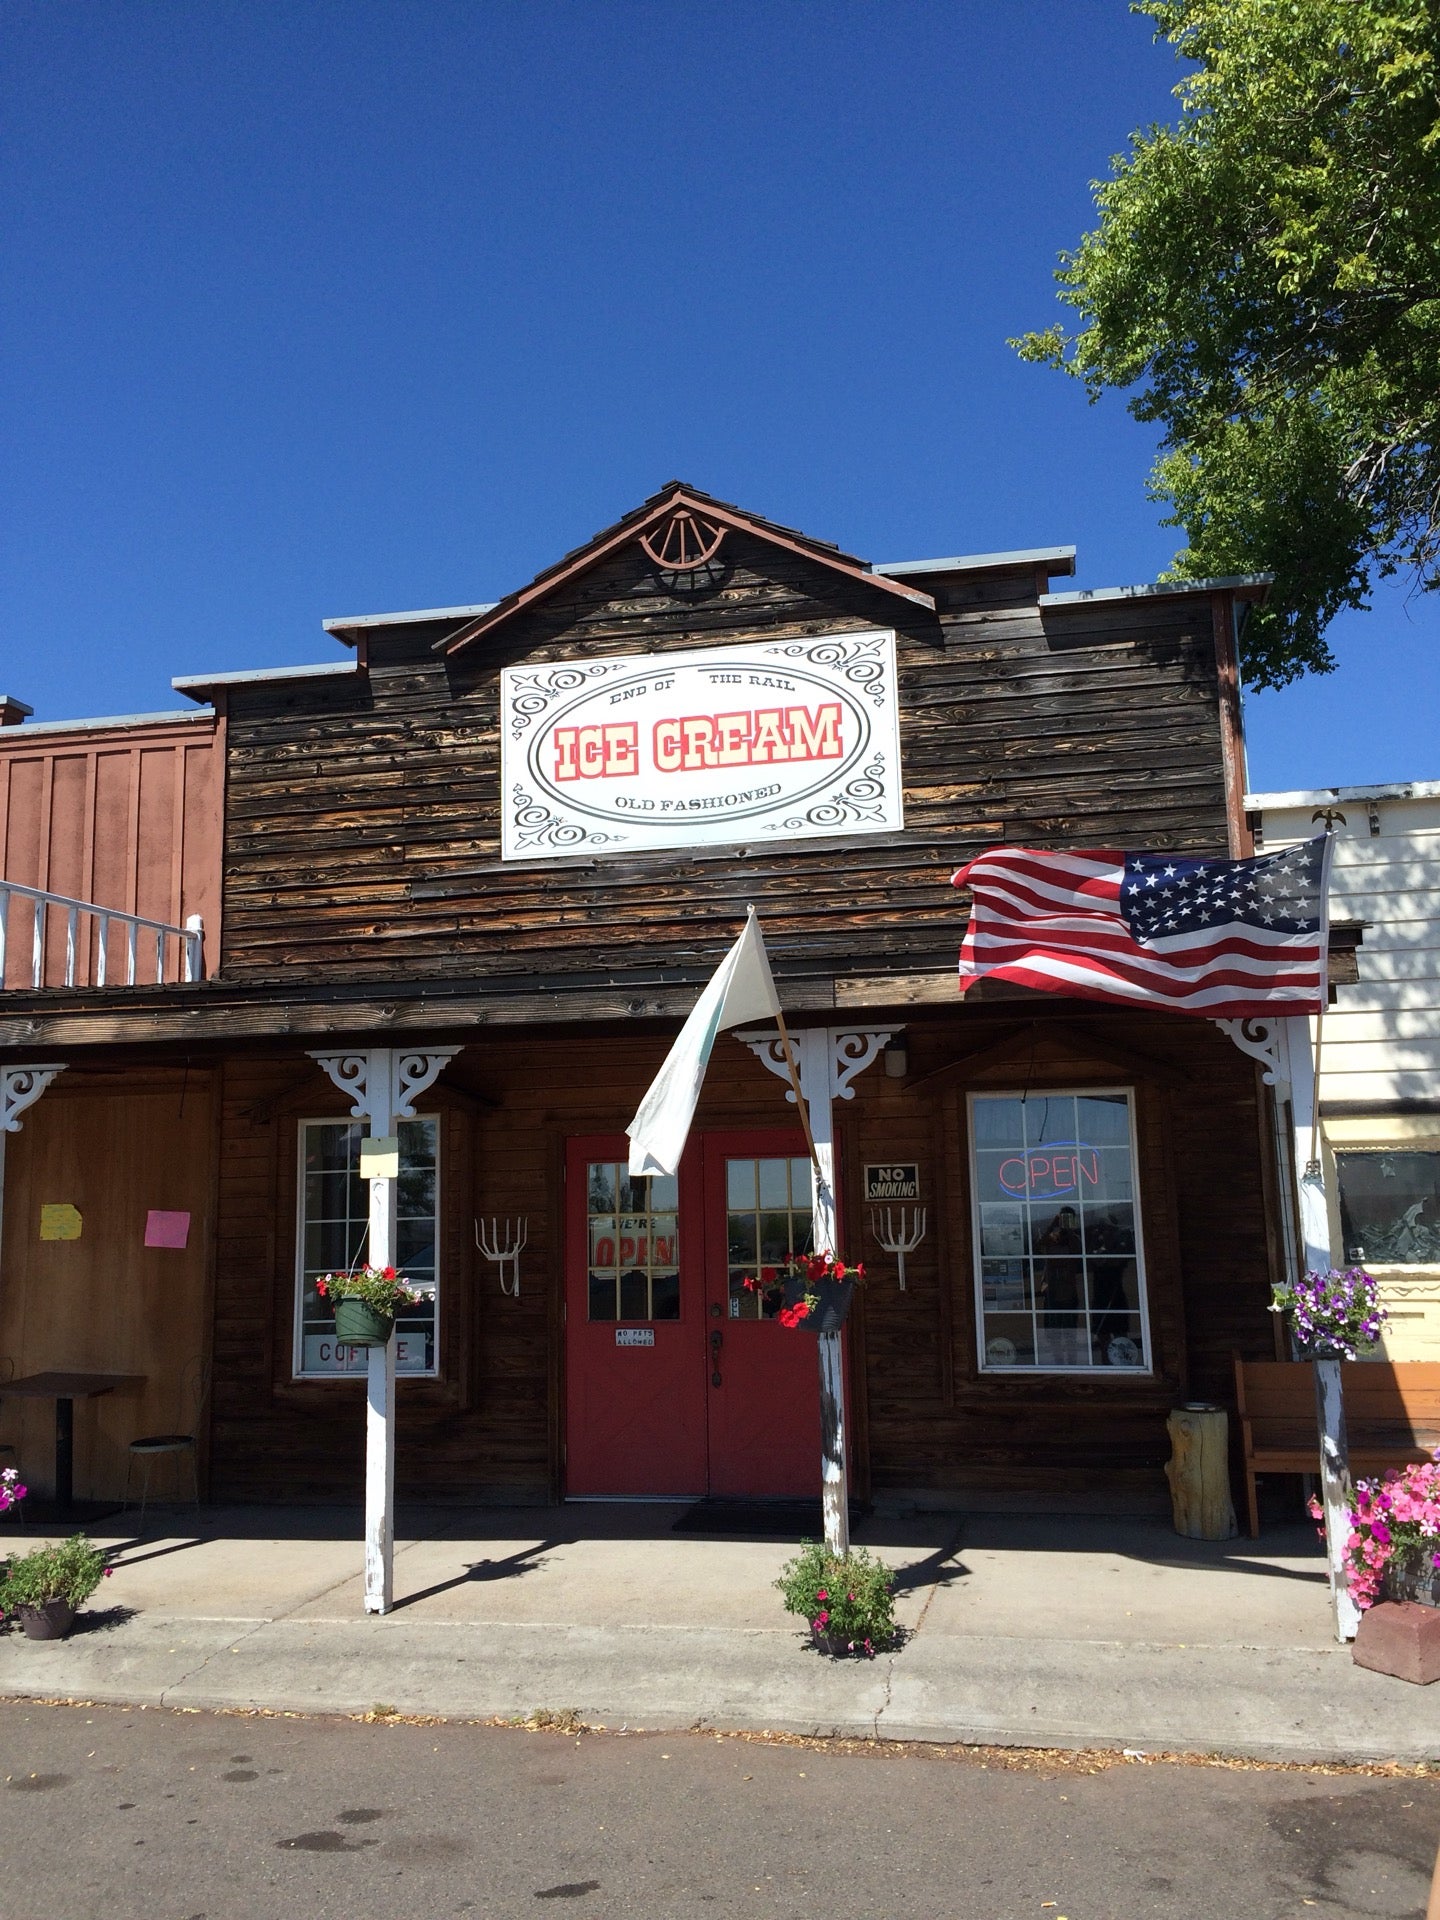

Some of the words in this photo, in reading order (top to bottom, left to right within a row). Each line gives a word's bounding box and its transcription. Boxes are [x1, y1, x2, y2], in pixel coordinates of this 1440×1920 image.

[609, 685, 647, 705] END
[654, 679, 675, 692] OF
[709, 674, 742, 684] THE
[749, 675, 796, 692] RAIL
[554, 721, 639, 782] ICE
[652, 702, 843, 773] CREAM
[615, 796, 655, 811] OLD
[660, 783, 782, 811] FASHIONED
[878, 1168, 905, 1182] NO
[999, 1151, 1099, 1189] OPEN
[869, 1181, 916, 1198] SMOKING
[596, 1235, 675, 1267] OPEN
[320, 1342, 408, 1361] COFE
